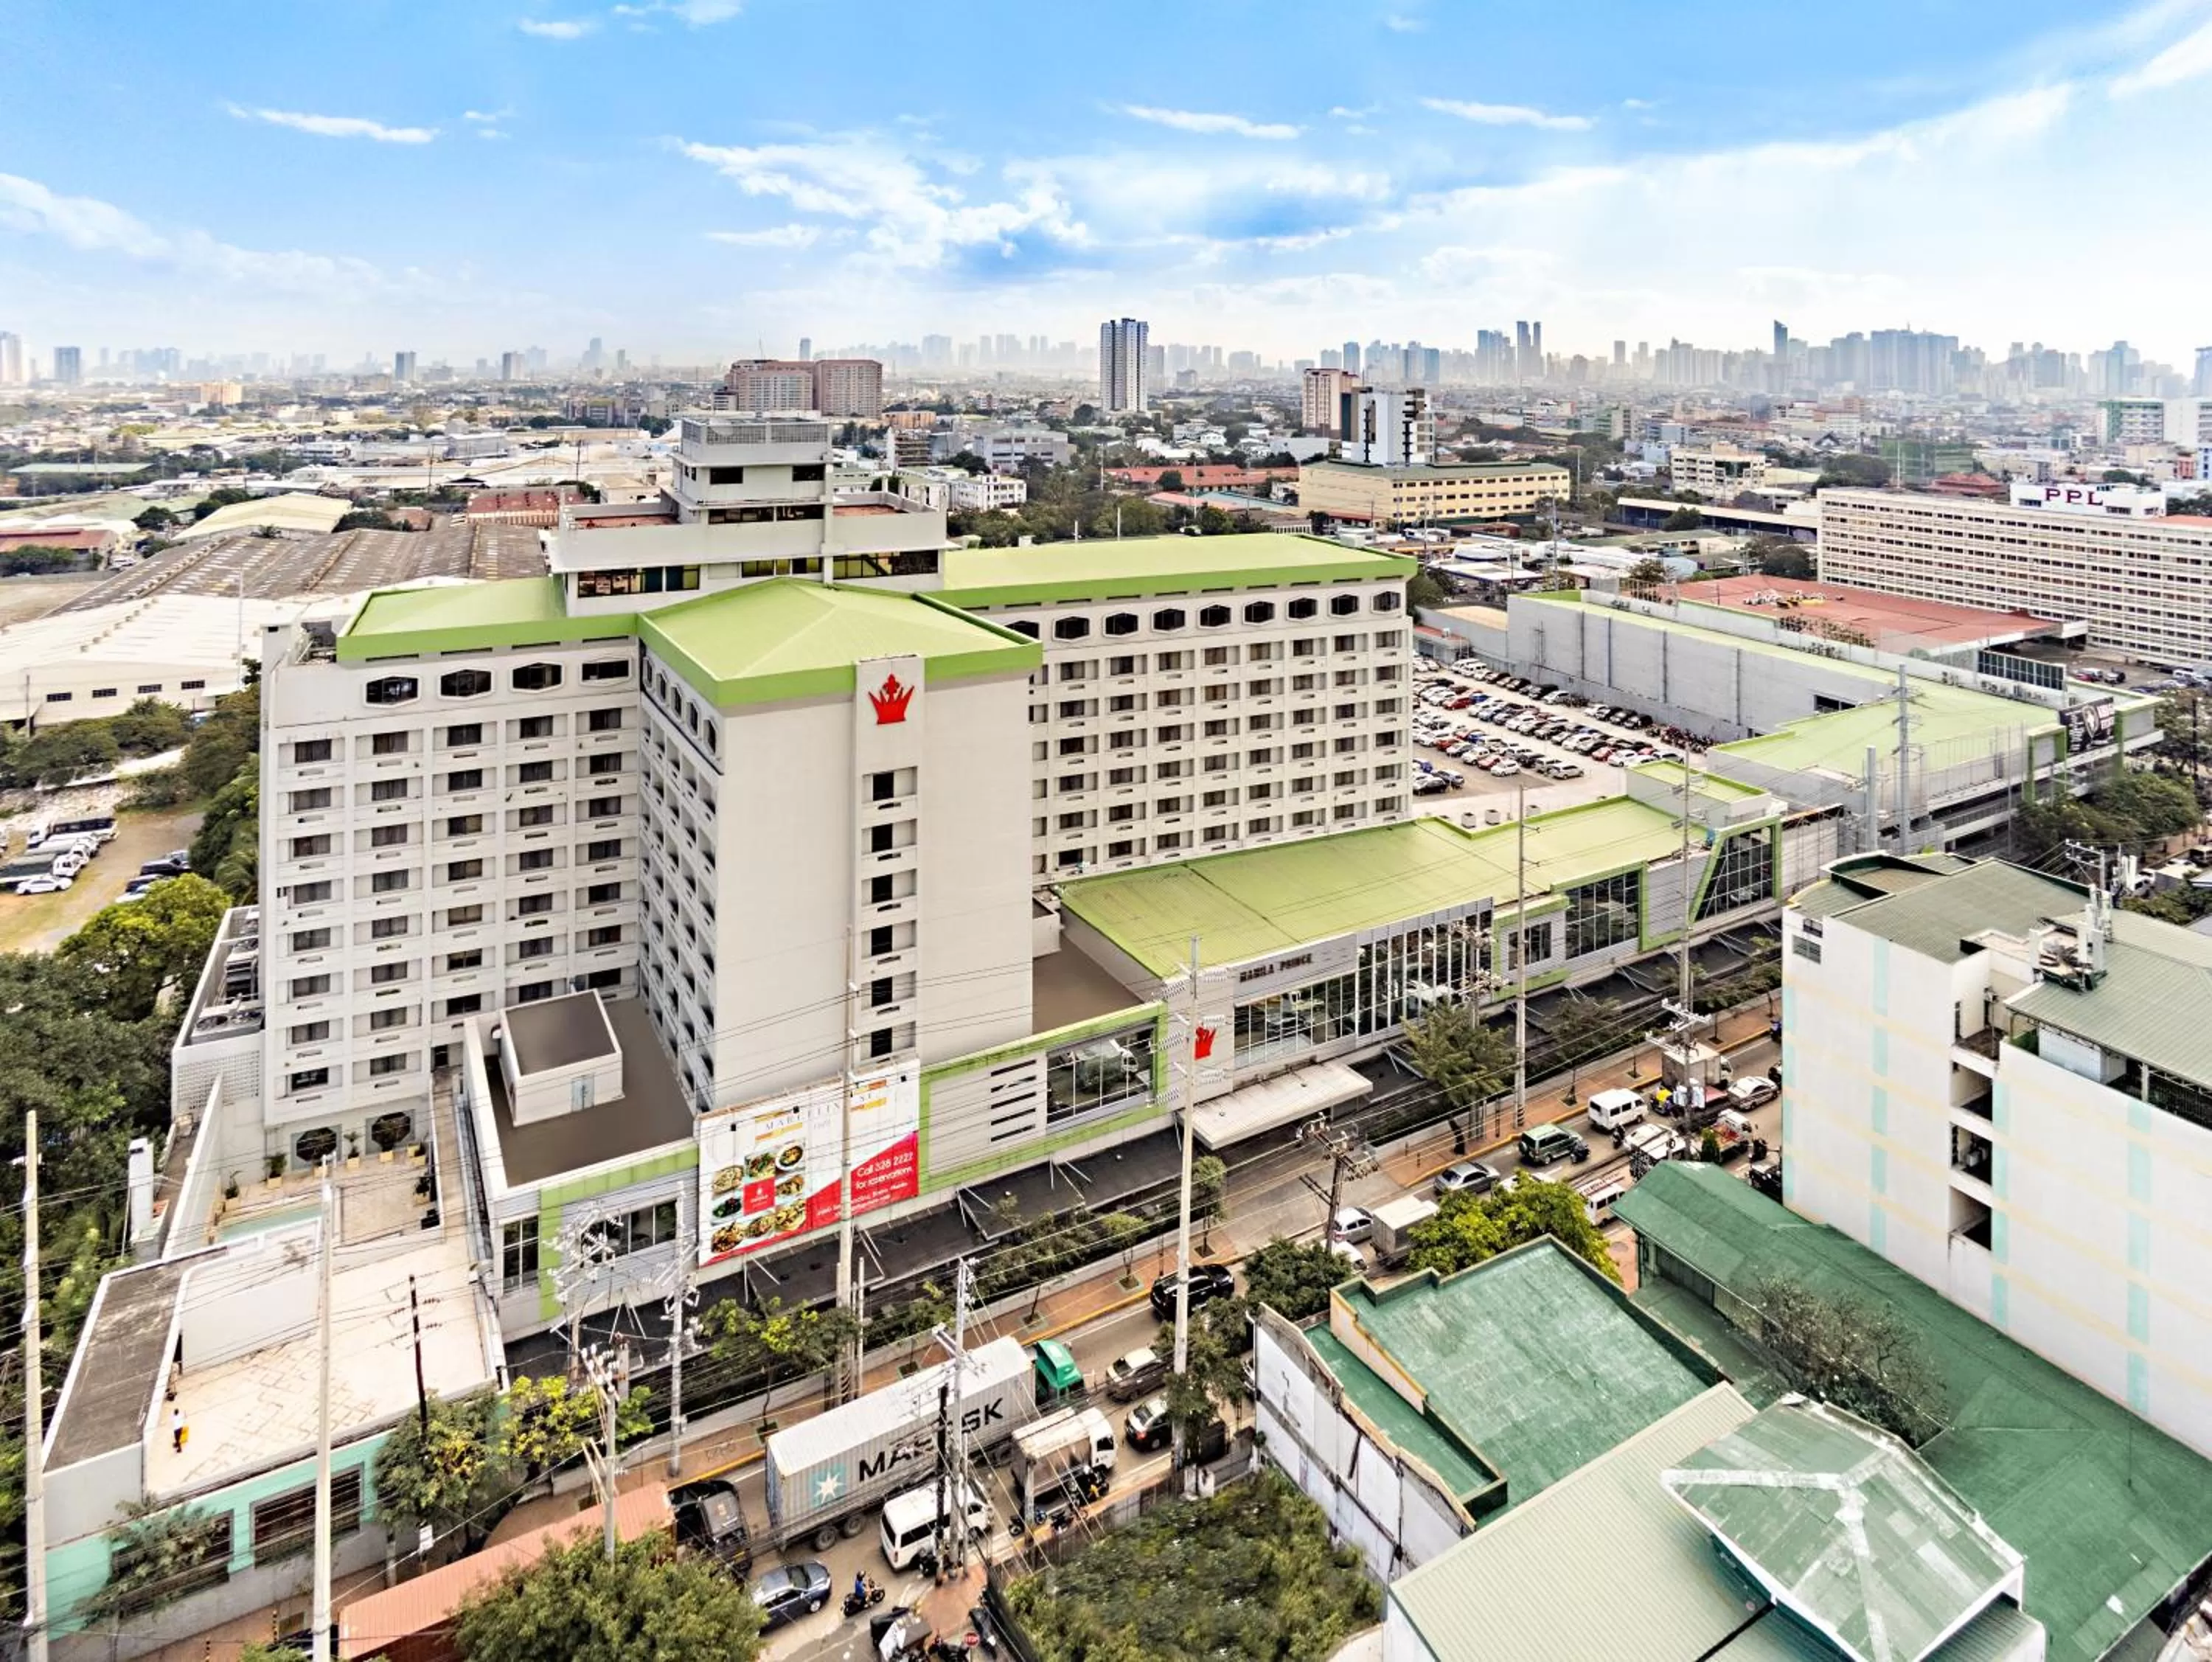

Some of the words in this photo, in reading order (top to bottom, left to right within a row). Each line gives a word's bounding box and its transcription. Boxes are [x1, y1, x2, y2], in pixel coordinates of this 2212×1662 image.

[2045, 487, 2104, 506] PPL
[857, 1165, 874, 1177] Call
[855, 1181, 867, 1189] for
